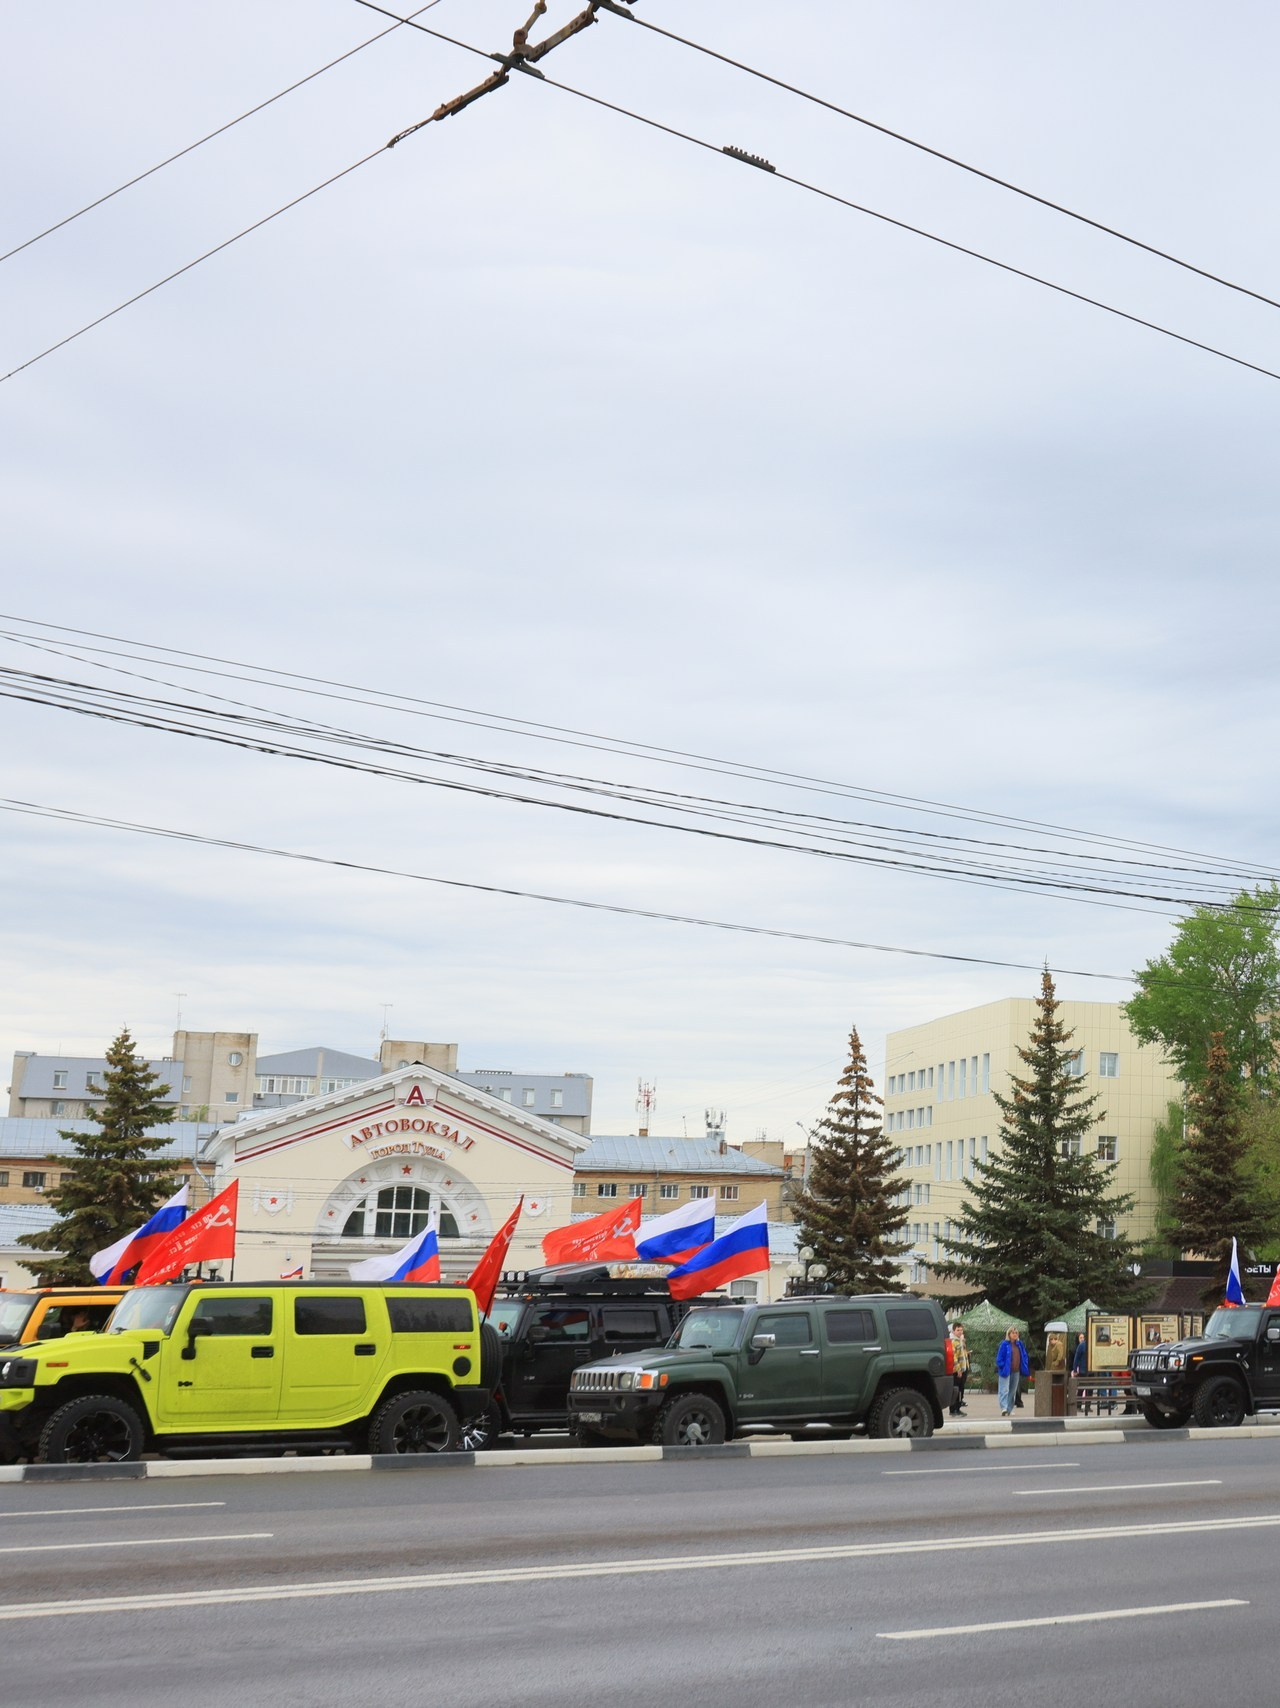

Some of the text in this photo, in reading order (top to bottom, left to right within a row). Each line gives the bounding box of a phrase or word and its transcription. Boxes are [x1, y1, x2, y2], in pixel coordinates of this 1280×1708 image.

[406, 1085, 425, 1105] А
[350, 1118, 476, 1150] АВТОВОКЗАЛ
[1244, 1265, 1271, 1273] ВЕТЫ
